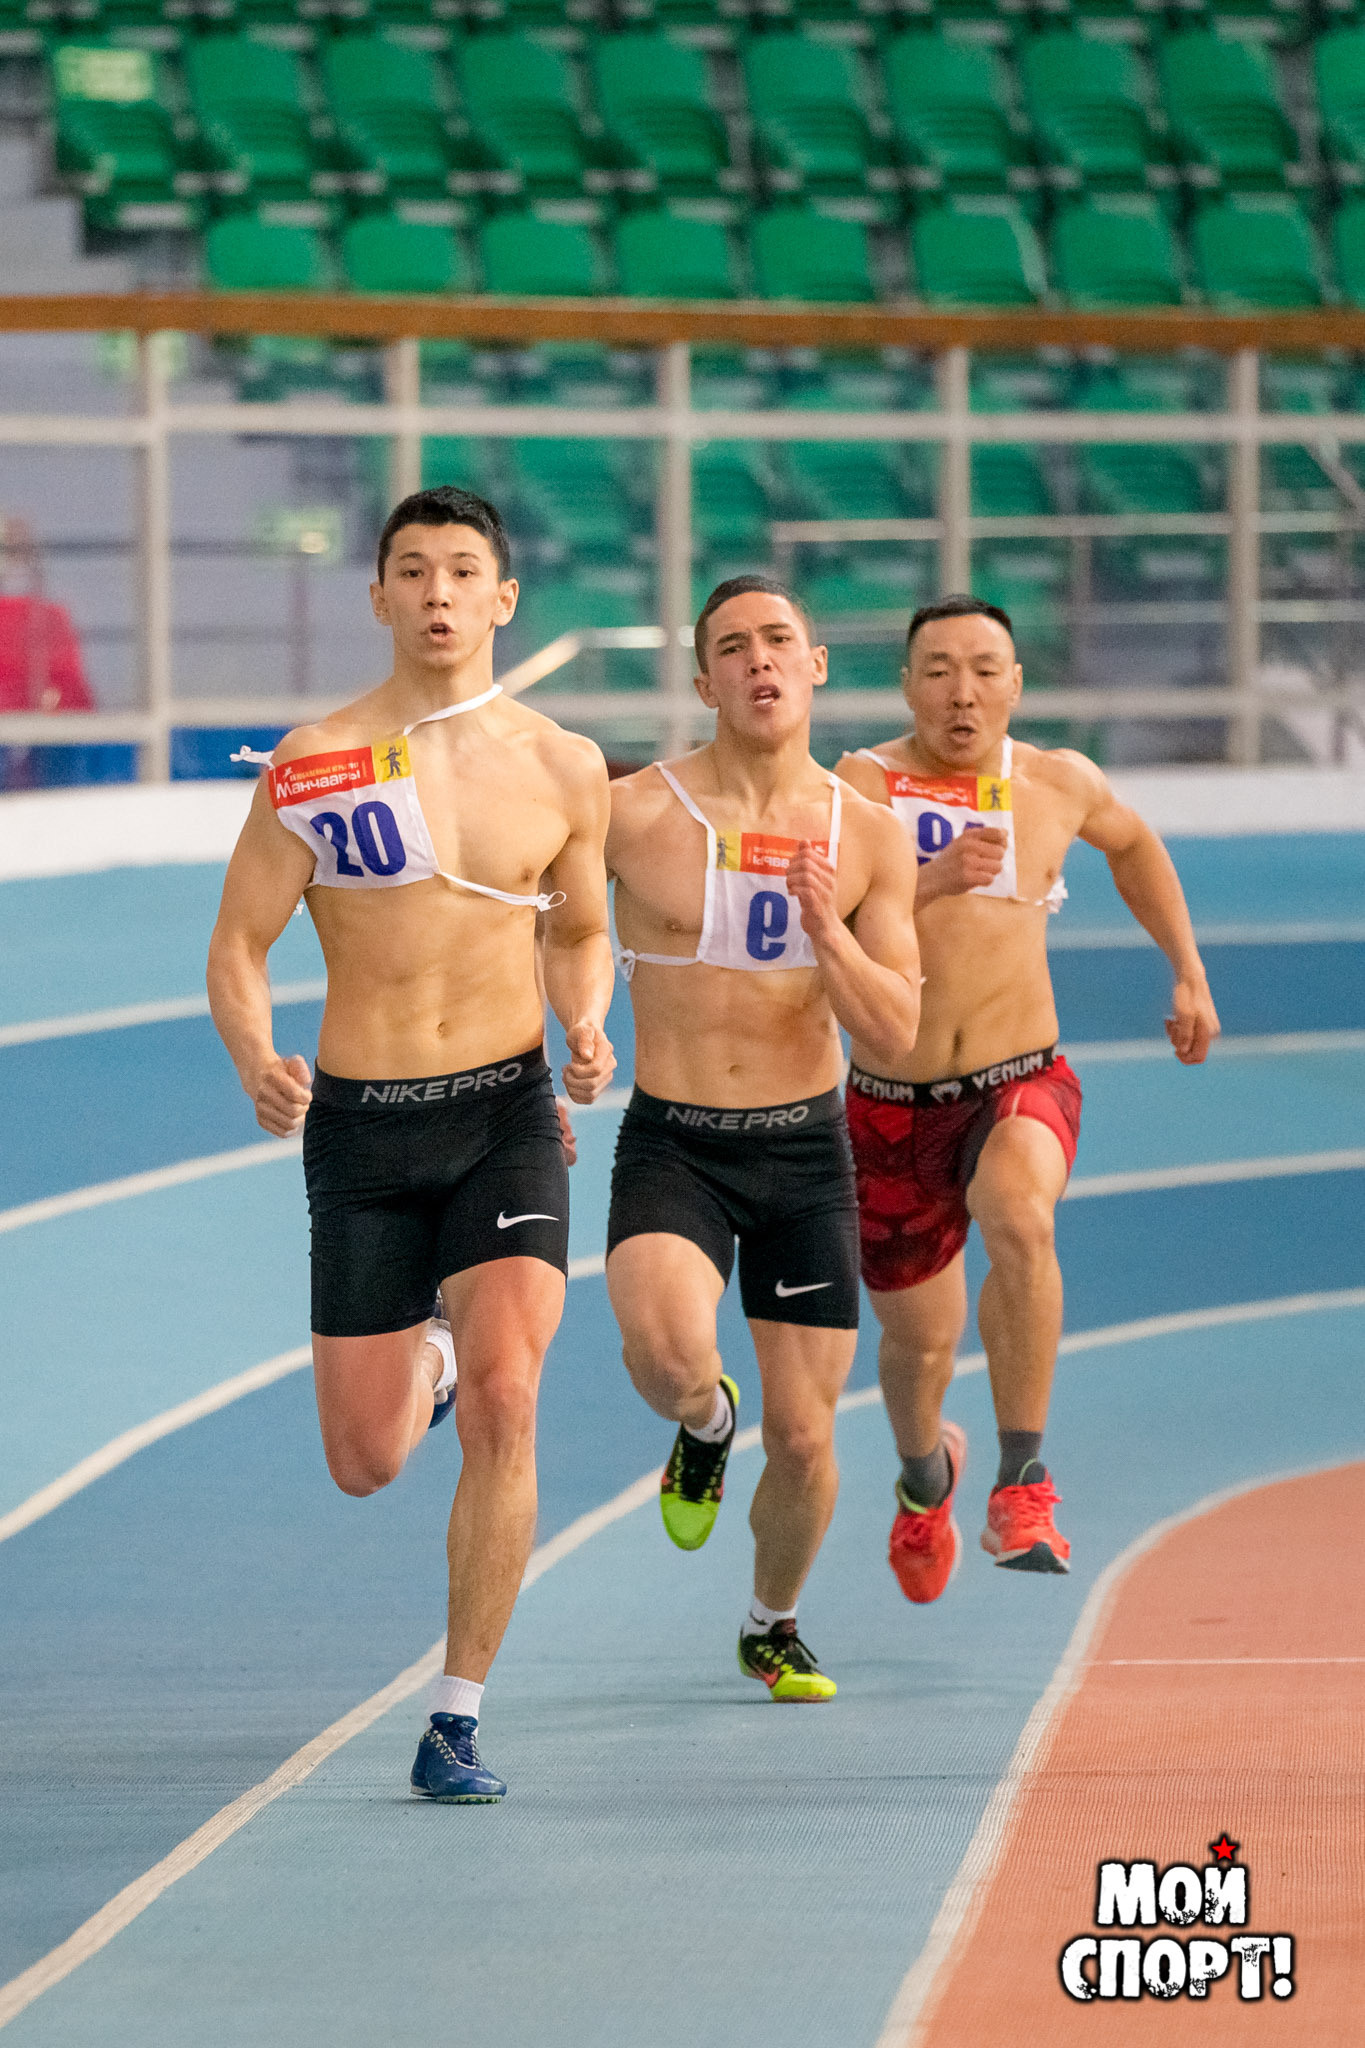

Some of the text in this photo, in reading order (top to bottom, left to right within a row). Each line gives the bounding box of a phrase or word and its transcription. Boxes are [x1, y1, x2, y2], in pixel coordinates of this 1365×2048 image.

[276, 770, 361, 799] Манчаары
[309, 800, 407, 877] 20
[852, 1053, 1044, 1101] VENUM VENUM
